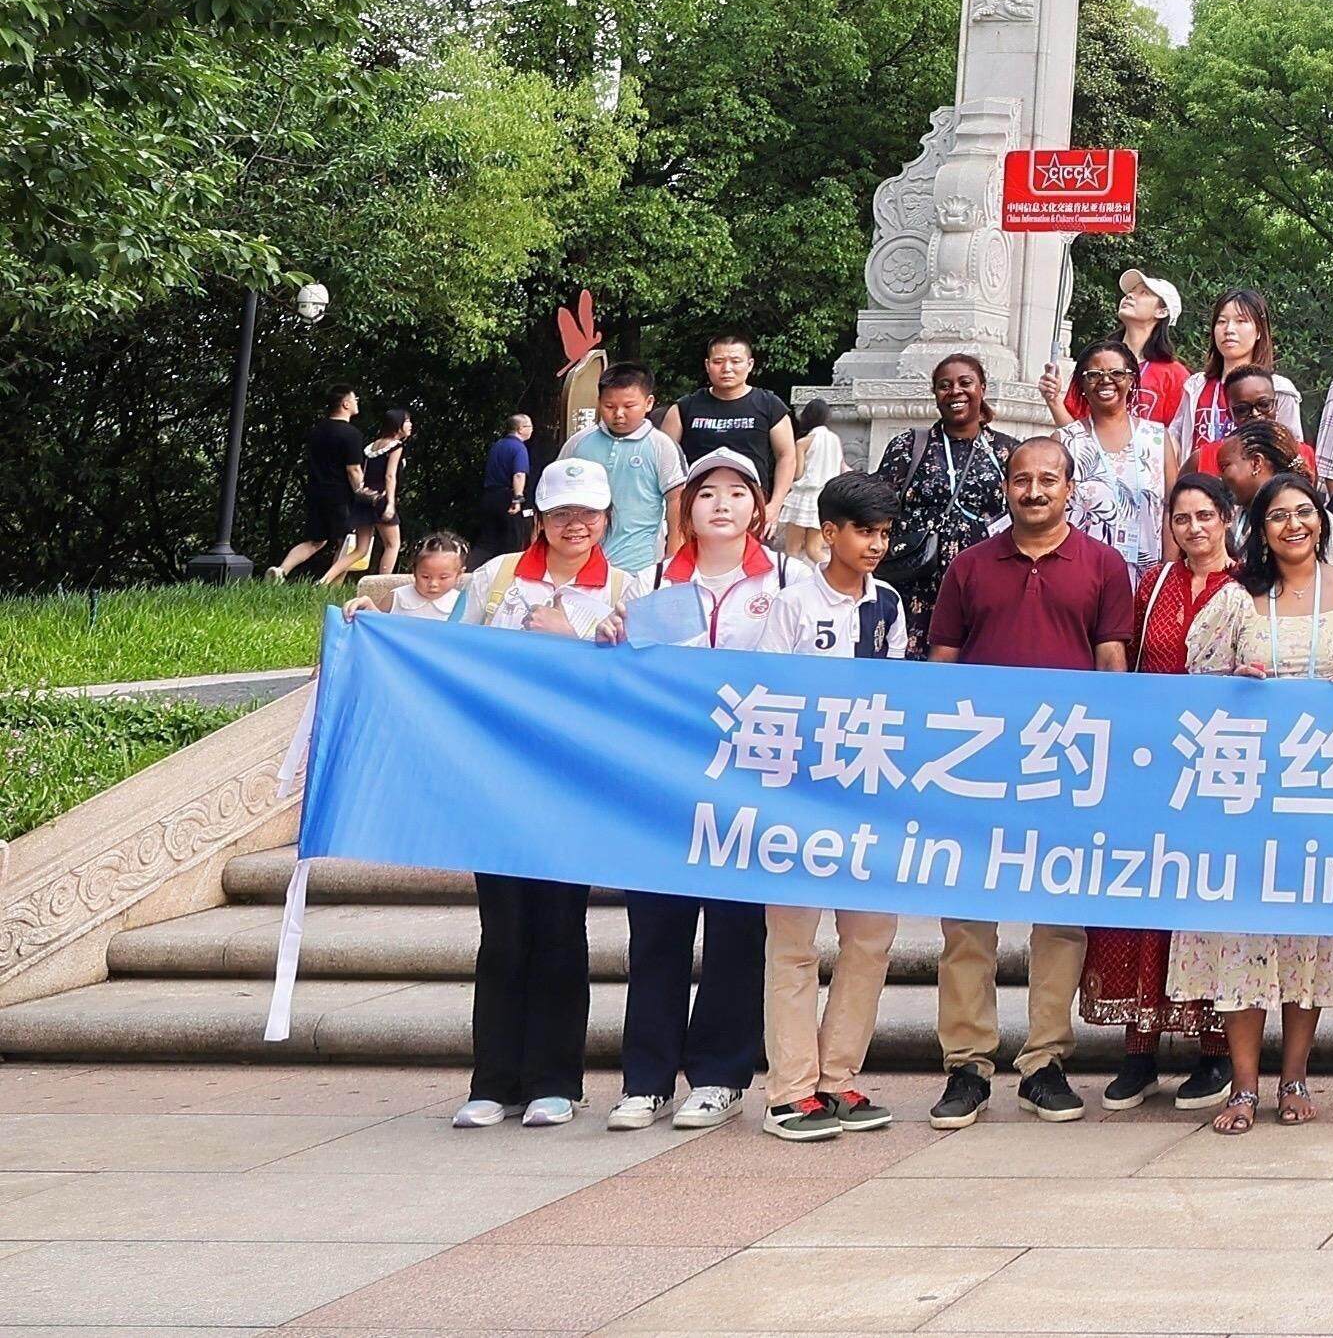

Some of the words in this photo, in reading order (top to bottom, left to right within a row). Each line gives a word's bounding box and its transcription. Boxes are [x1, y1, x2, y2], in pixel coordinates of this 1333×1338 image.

[1049, 166, 1092, 179] CICCK
[815, 619, 837, 650] 5
[687, 802, 879, 881] Meet
[896, 820, 962, 887] in
[985, 827, 1237, 901] Haizhu
